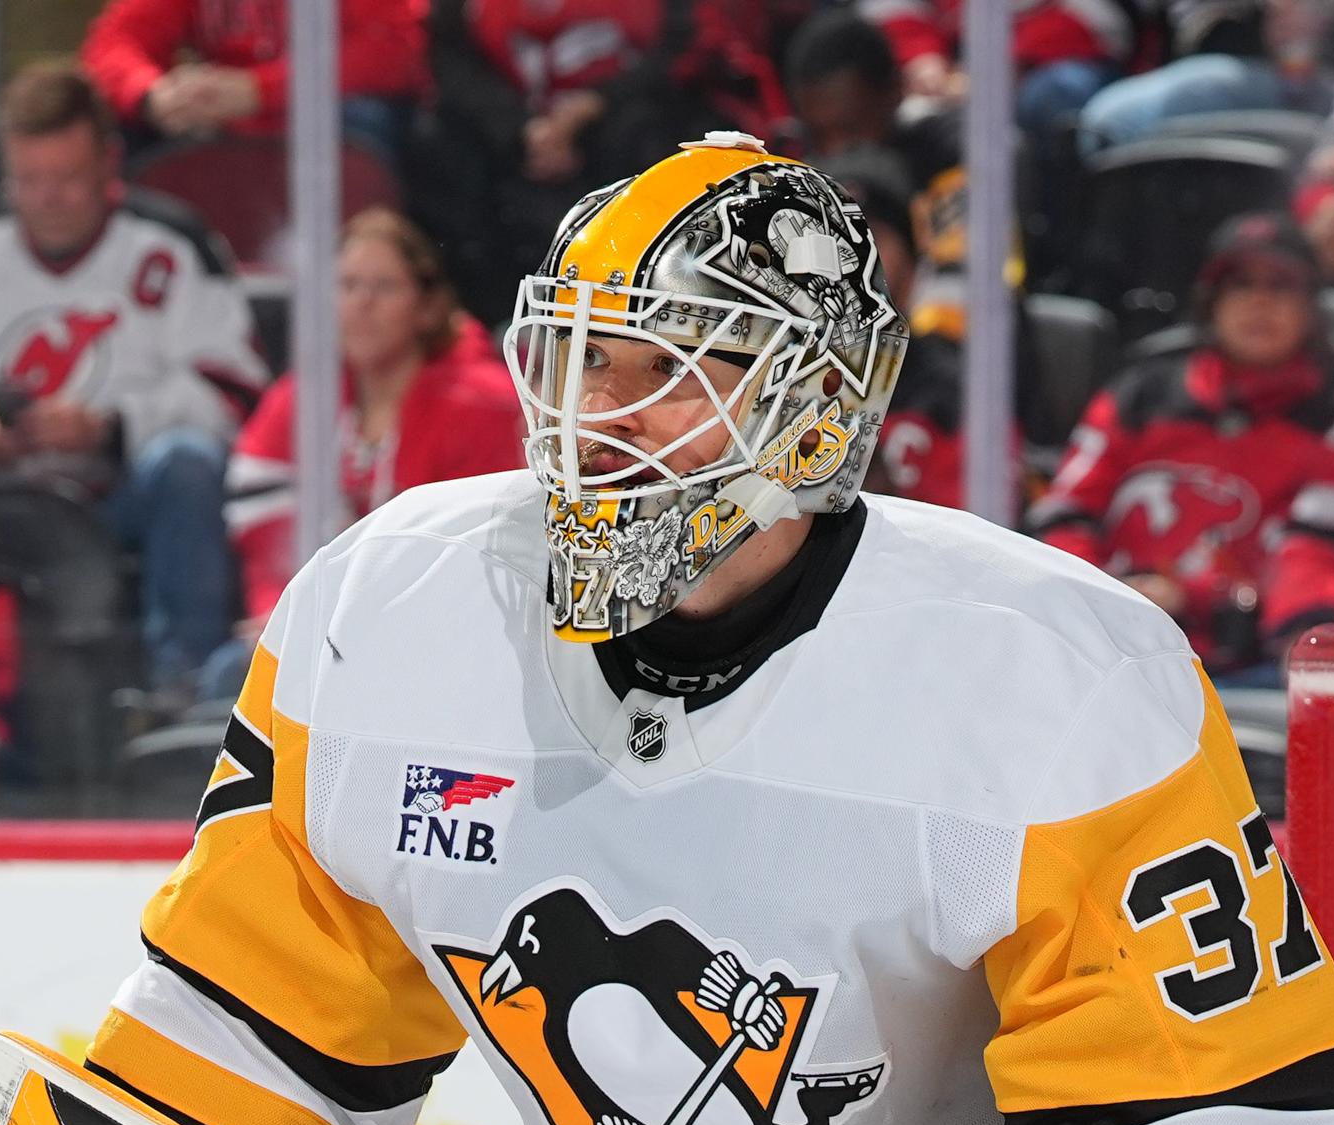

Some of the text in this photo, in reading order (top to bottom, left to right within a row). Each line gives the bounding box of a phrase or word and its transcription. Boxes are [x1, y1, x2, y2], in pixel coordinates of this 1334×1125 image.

[635, 658, 742, 692] CCM
[634, 726, 662, 751] NHL
[396, 813, 497, 865] F.N.B.
[1122, 806, 1324, 1023] 37
